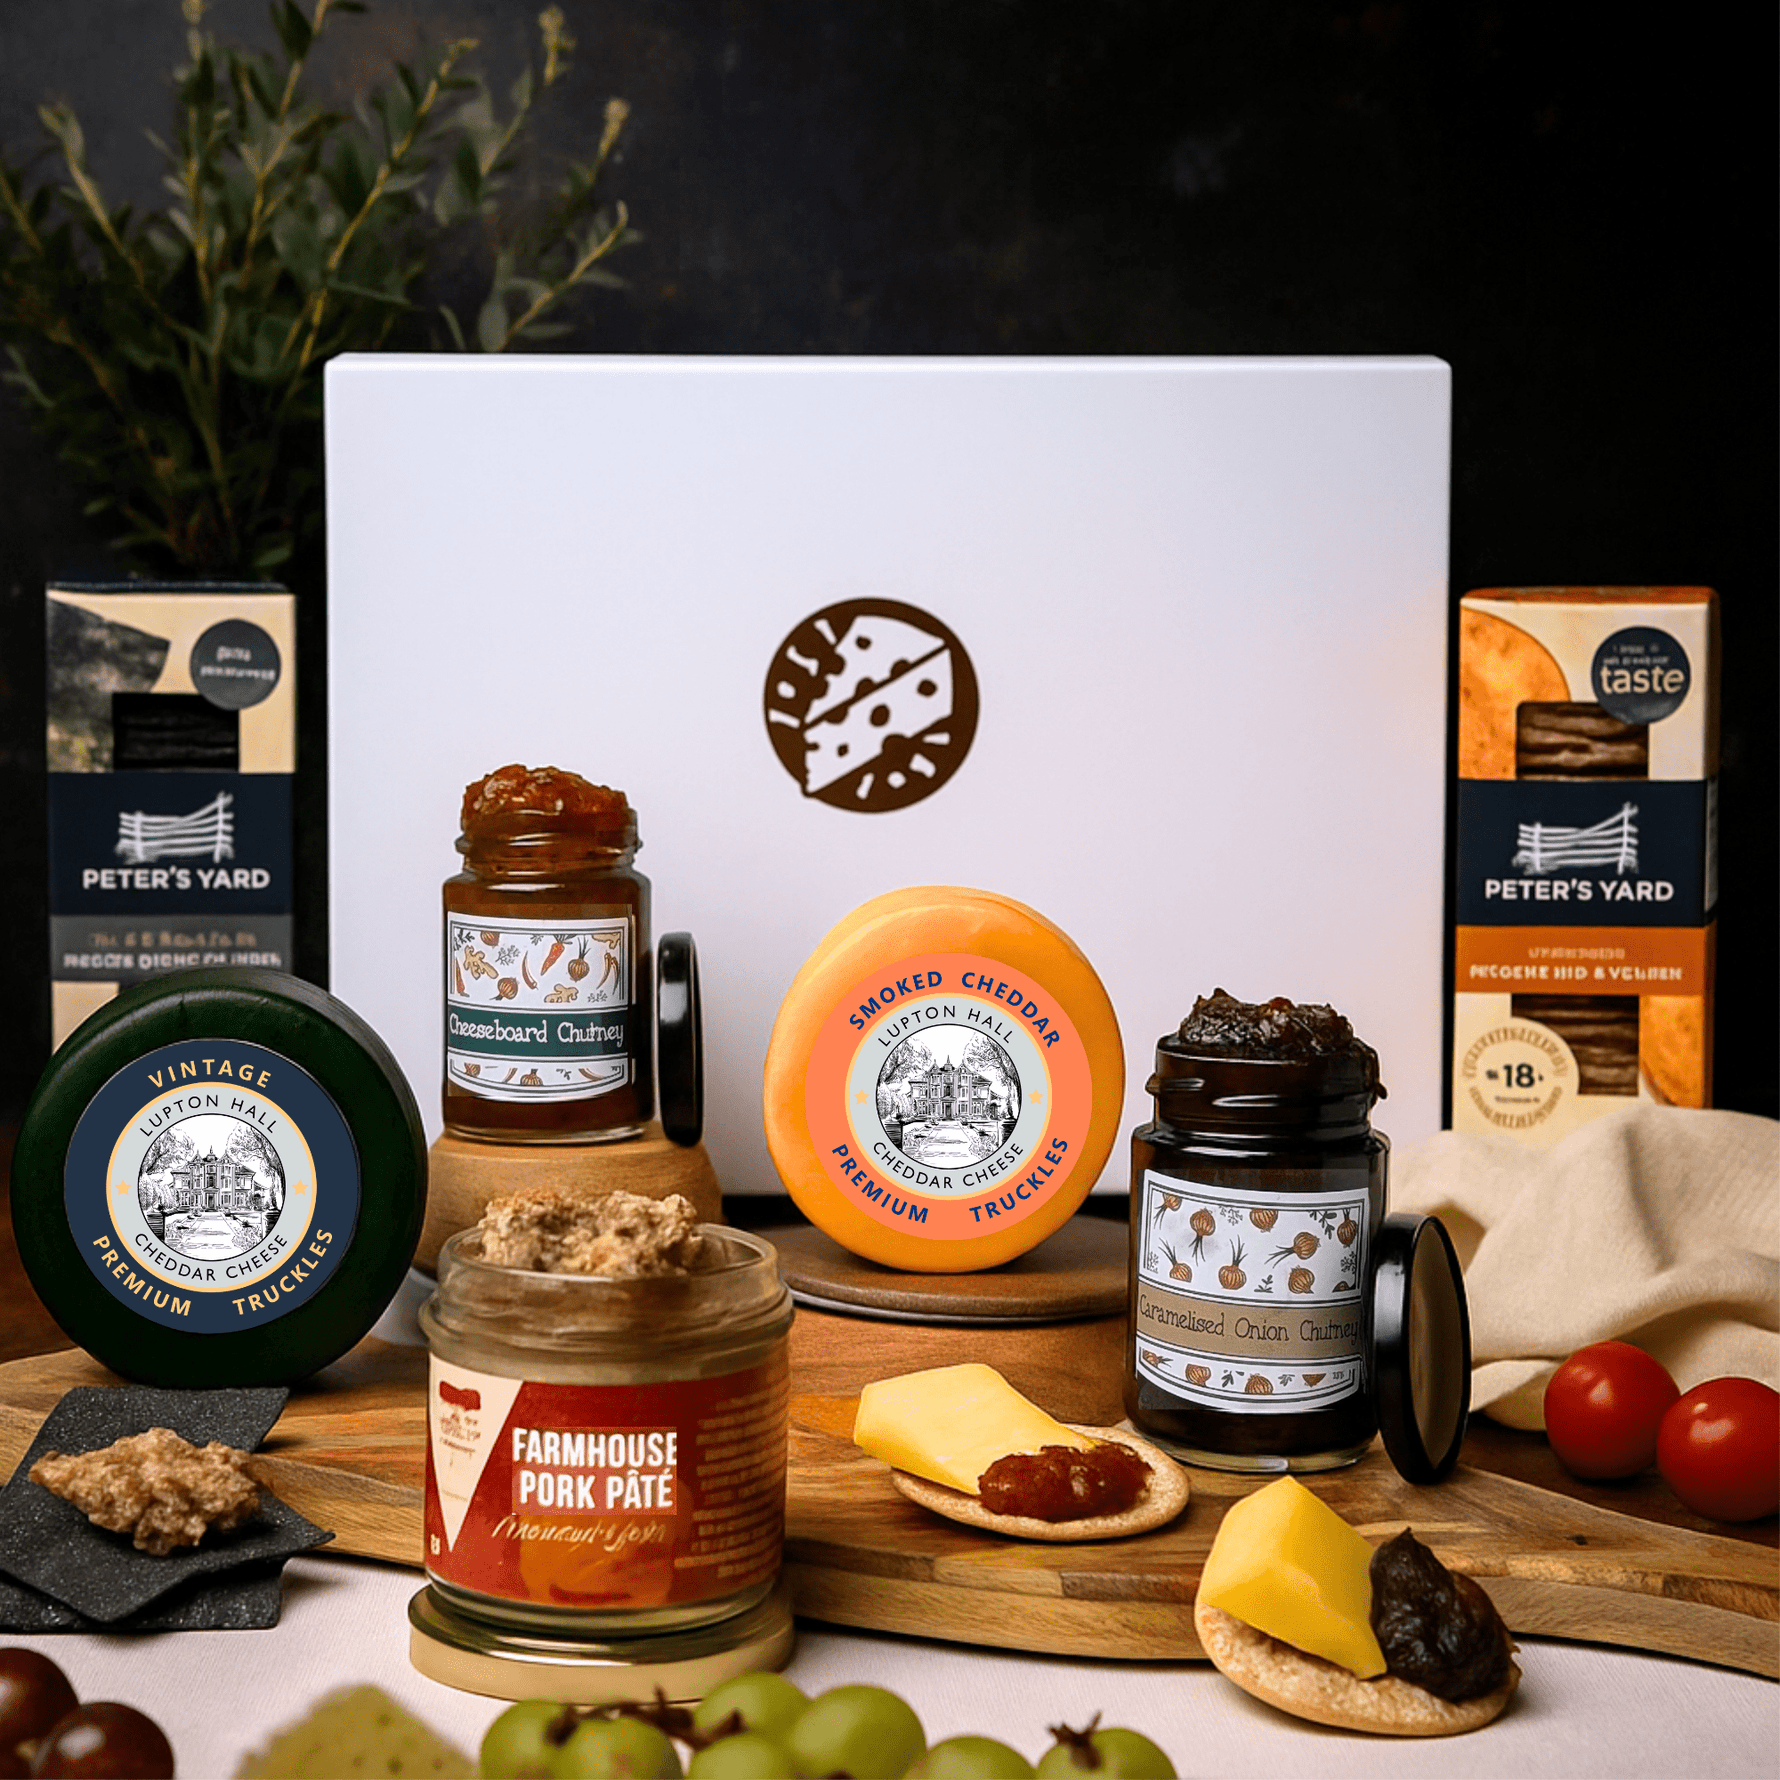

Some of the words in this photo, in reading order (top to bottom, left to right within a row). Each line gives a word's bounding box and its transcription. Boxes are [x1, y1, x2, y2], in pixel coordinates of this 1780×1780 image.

[1600, 665, 1685, 694] taste
[82, 866, 191, 889] PETER'S
[197, 868, 271, 889] YARD
[1484, 878, 1593, 901] PETER'S
[1599, 880, 1674, 901] YARD
[849, 971, 943, 1031] SMOKED
[961, 972, 1061, 1049] CHEDDAR
[877, 1005, 956, 1047] LUPTON
[967, 1008, 1013, 1044] HALL
[450, 1014, 548, 1043] Cheeseboard
[557, 1020, 624, 1048] Chutney
[148, 1058, 272, 1089] VINTAGE
[1503, 1063, 1535, 1088] 18
[139, 1094, 219, 1137] LUPTON
[230, 1097, 278, 1134] HALL
[831, 1143, 929, 1223] PREMIUM
[969, 1137, 1068, 1222] TRUCKLES
[873, 1141, 953, 1189] CHEDDAR
[962, 1143, 1024, 1187] CHEESE
[92, 1235, 192, 1316] PREMIUM
[232, 1229, 333, 1315] TRUCKLES
[135, 1233, 217, 1281] CHEDDAR
[225, 1234, 288, 1279] CHEESE
[1139, 1295, 1225, 1337] Caramelised
[1234, 1317, 1289, 1341] Onion
[1299, 1319, 1359, 1345] Chutney
[513, 1427, 677, 1467] FARMHOUSE
[520, 1470, 596, 1509] PORK
[606, 1469, 673, 1509] PÂTÉ
